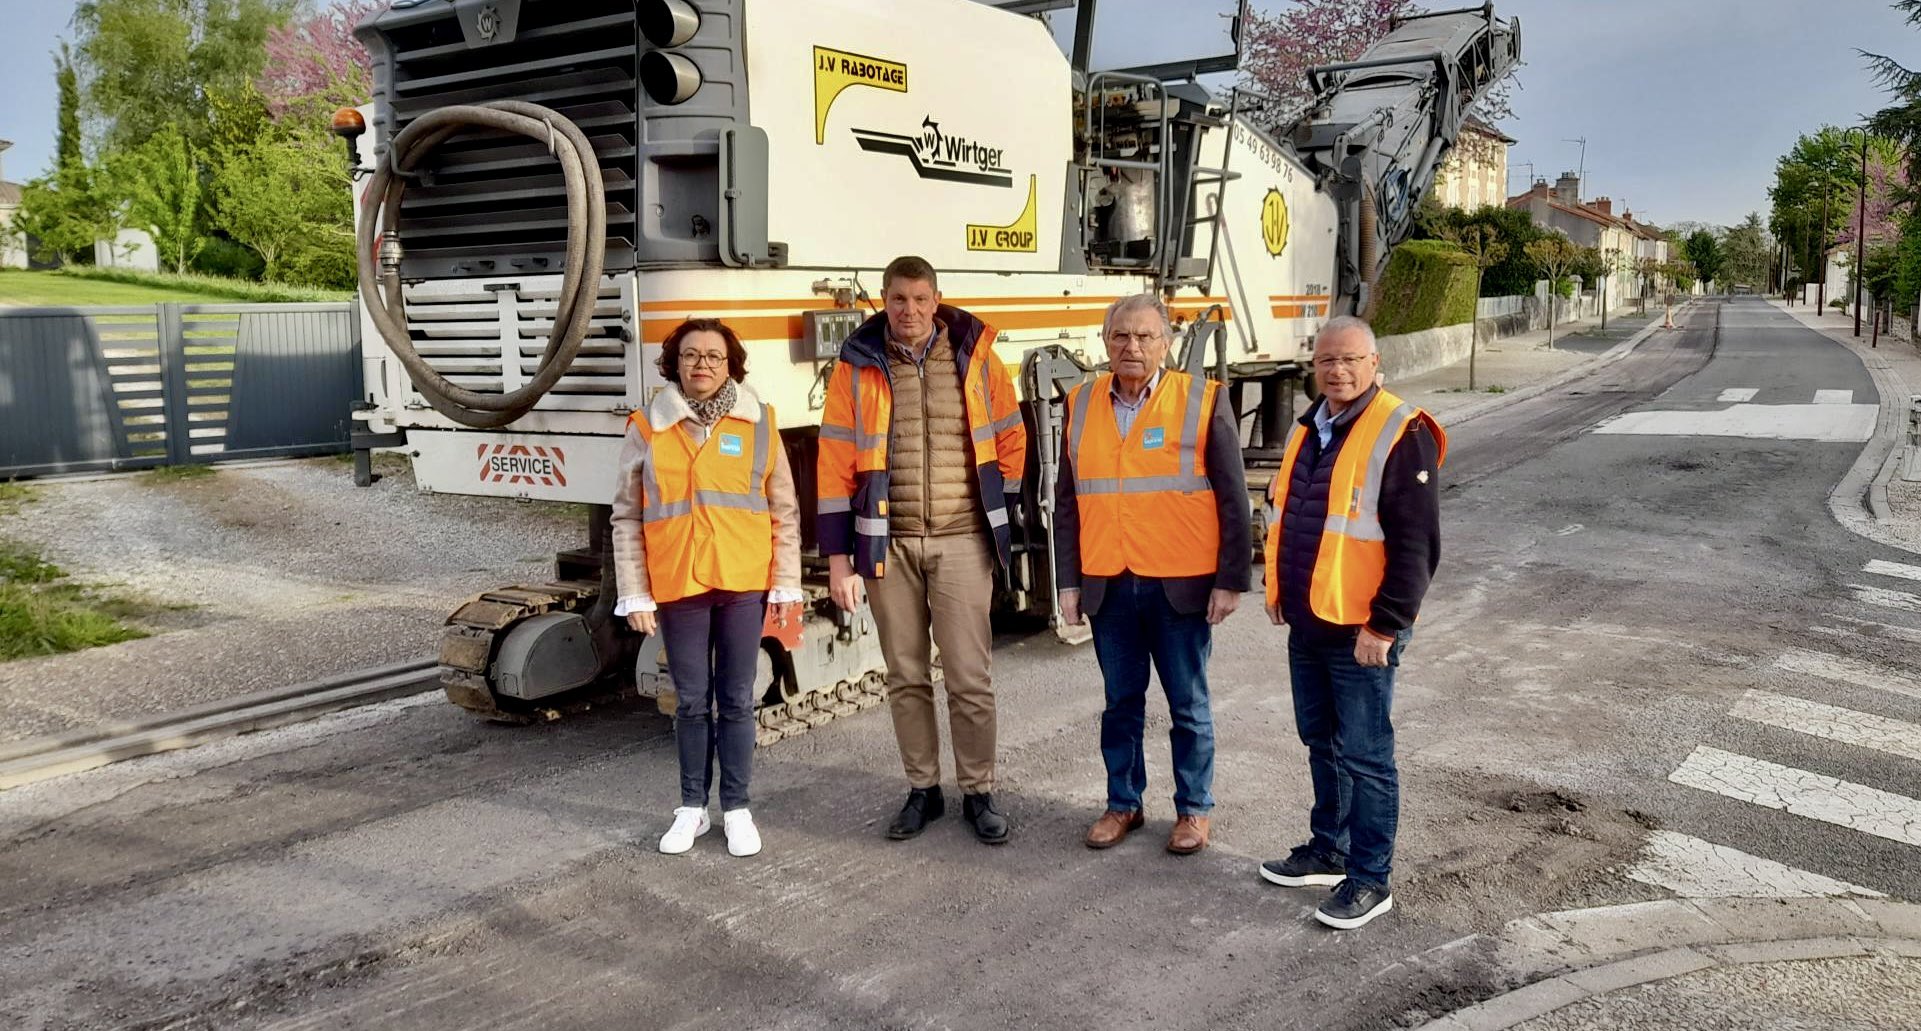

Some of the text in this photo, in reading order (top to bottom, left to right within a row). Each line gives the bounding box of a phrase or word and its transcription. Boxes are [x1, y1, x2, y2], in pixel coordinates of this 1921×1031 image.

[819, 55, 904, 86] J.V RABOTAGE
[924, 132, 1003, 172] W Wirtger
[1234, 123, 1293, 183] 05 49 63 98 76
[971, 229, 1033, 248] J.V GROUP
[491, 456, 551, 475] SERVICE
